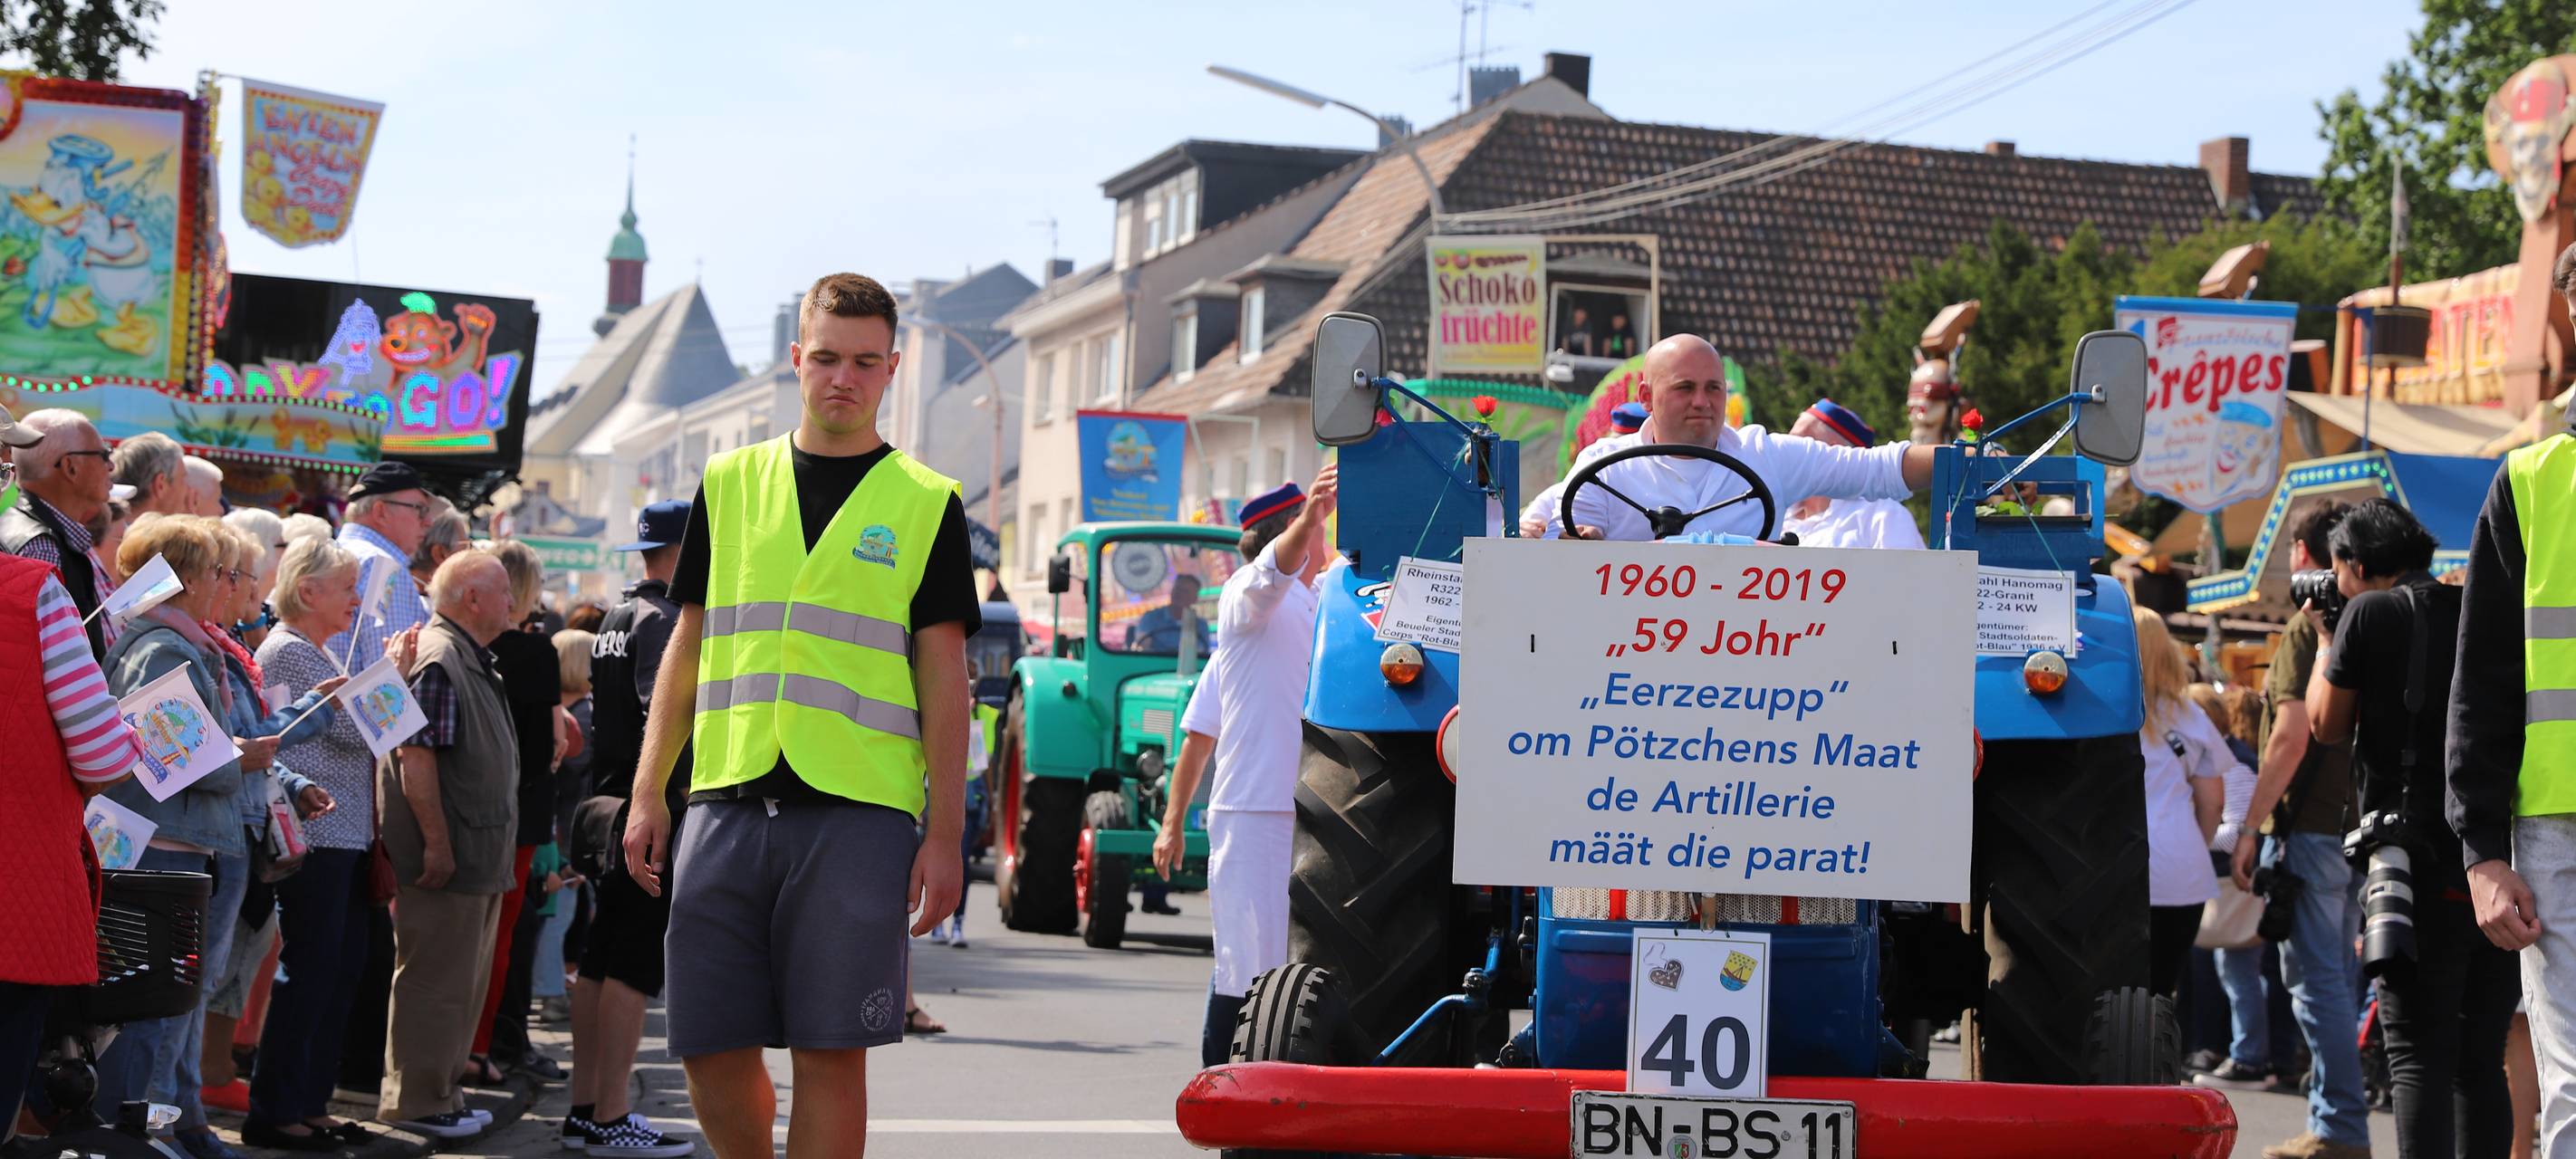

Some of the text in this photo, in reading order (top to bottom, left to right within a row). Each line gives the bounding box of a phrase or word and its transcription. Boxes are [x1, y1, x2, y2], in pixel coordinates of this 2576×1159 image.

[262, 105, 359, 145] ENTEN
[1438, 273, 1536, 305] Schoko
[1407, 568, 1463, 583] Rheinsta
[1430, 583, 1461, 596] R322
[1594, 563, 1697, 598] 1960
[1737, 567, 1847, 604] 2019
[1977, 577, 2063, 591] ahl Hanomag
[1425, 596, 1453, 607] 1962
[1976, 589, 2034, 600] 22-Granit
[1996, 602, 2012, 611] 24
[2015, 603, 2038, 613] KW
[1382, 628, 1413, 640] Corps
[1396, 620, 1435, 633] Beueler
[1605, 618, 1826, 657] „59 Johr“
[1979, 631, 2058, 641] Stadtsoldaten-
[1580, 672, 1849, 722] „Eerzezupp“
[1508, 724, 1921, 770] om Pötzchens Maat
[1587, 776, 1836, 819] de Artillerie
[1549, 831, 1870, 880] määt die parat!
[1640, 1013, 1751, 1090] 40
[1802, 1112, 1841, 1159] 11
